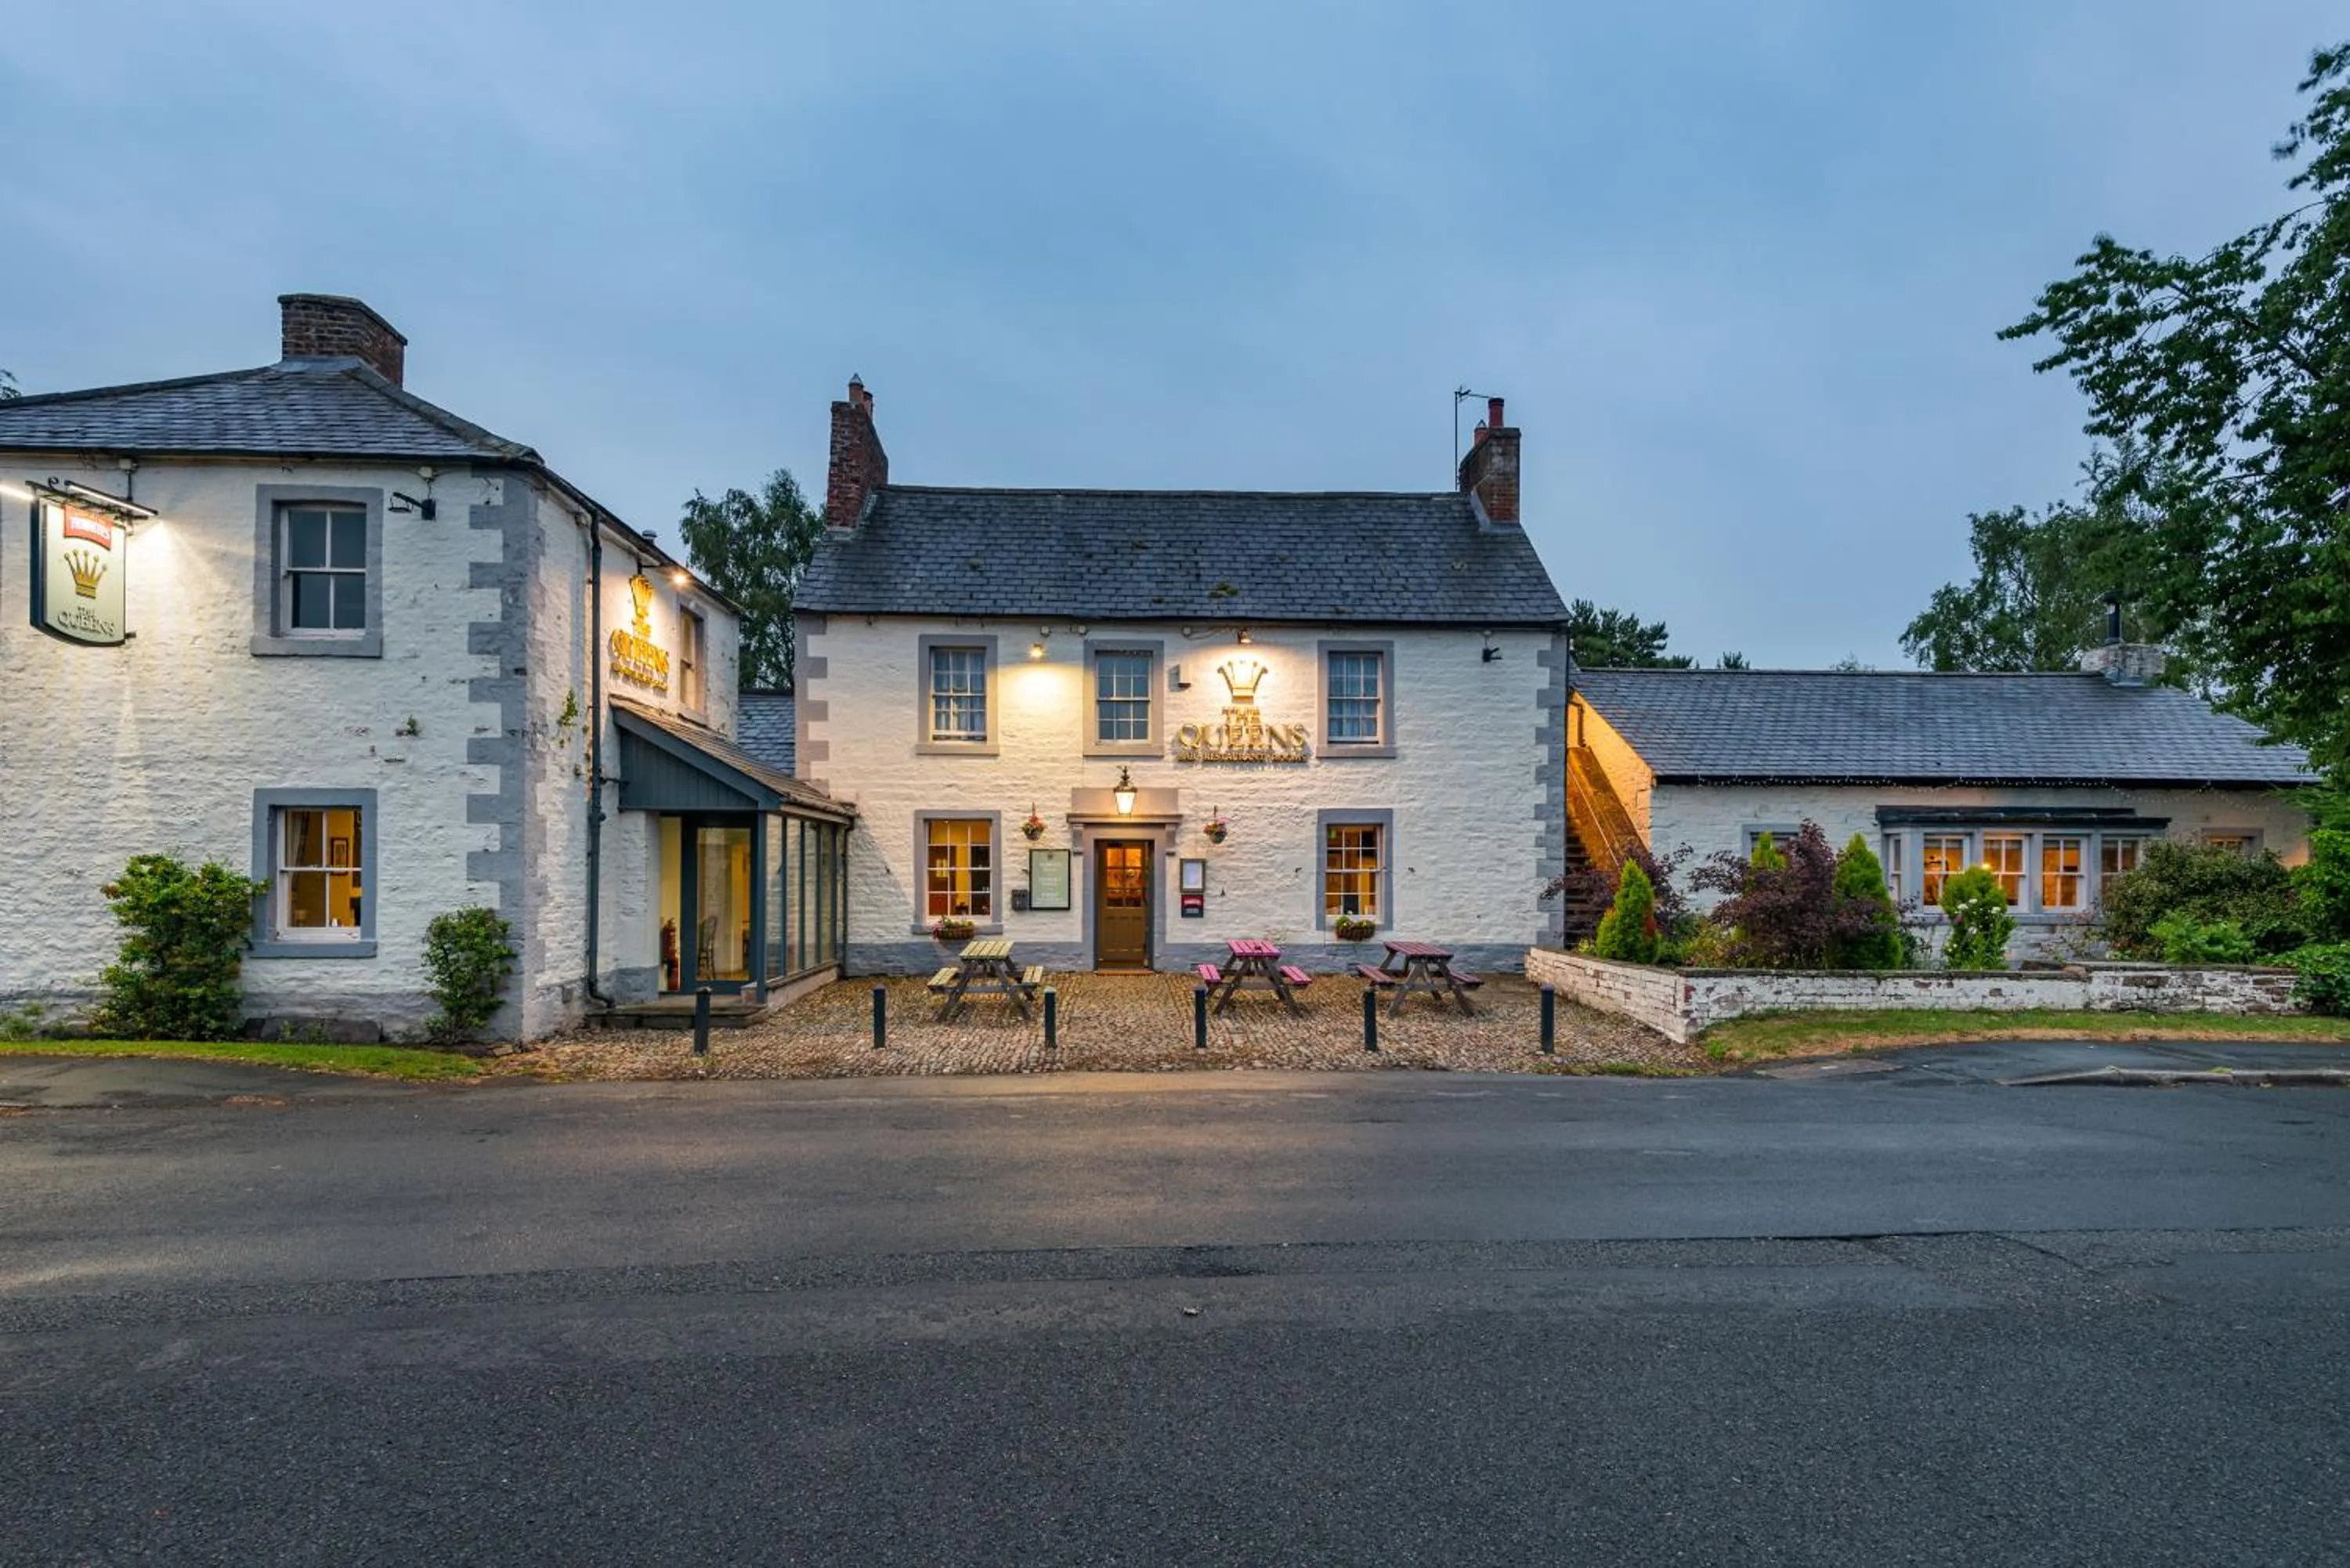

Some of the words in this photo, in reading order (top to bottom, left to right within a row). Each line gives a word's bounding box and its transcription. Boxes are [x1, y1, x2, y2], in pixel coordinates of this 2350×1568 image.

[57, 611, 116, 637] QUEENS
[1222, 705, 1260, 724] THE
[1178, 723, 1305, 750] QUEENS
[1203, 752, 1265, 762] RESTAURANT
